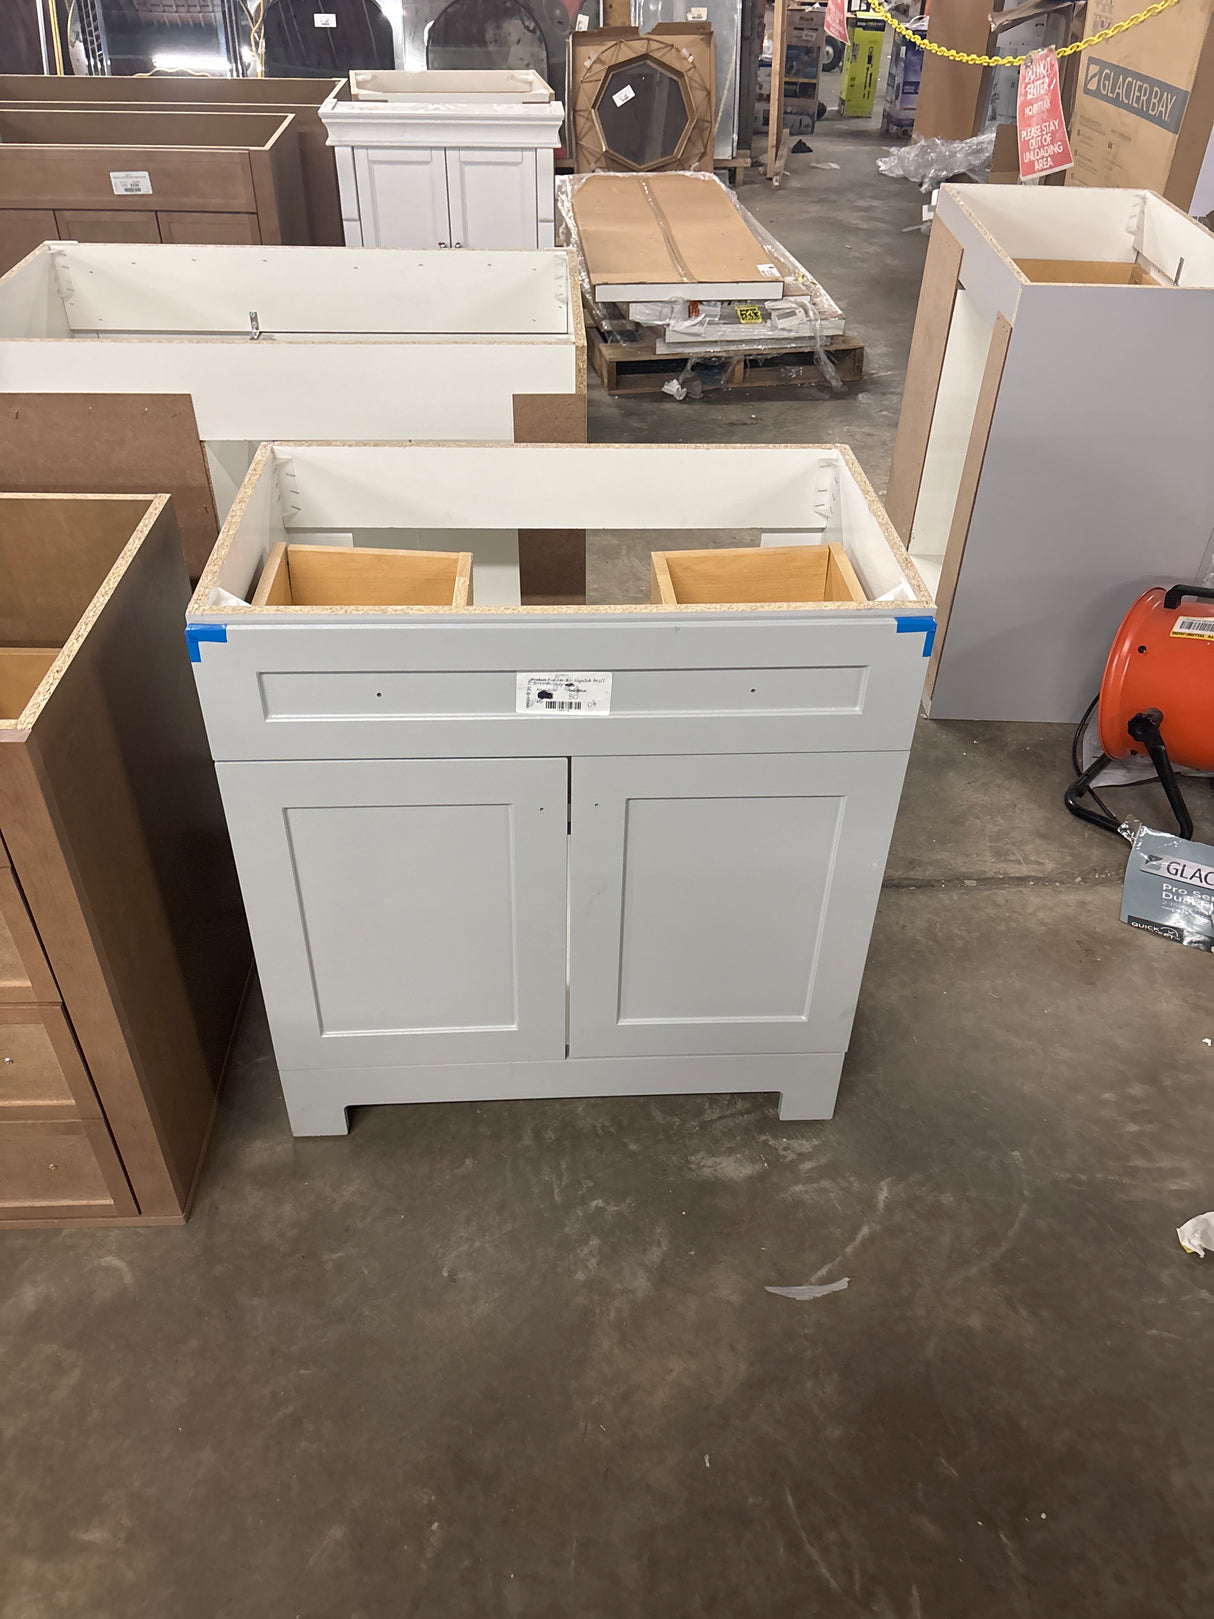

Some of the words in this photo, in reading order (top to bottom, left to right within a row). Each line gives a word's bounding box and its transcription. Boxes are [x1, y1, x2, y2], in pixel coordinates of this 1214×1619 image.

[1036, 57, 1051, 77] NOT
[1026, 78, 1049, 99] ENTER
[1100, 69, 1150, 111] GLACIER
[1149, 87, 1176, 122] BAY
[1021, 126, 1042, 141] PLEASE
[1042, 119, 1059, 133] STAY
[1029, 137, 1041, 150] OUT
[1042, 133, 1052, 145] OF
[1023, 142, 1063, 162] UNLOADING
[1034, 157, 1054, 172] AREA
[1166, 861, 1214, 886] GLAC
[1162, 883, 1188, 895] Pro
[1131, 921, 1160, 932] QUICK
